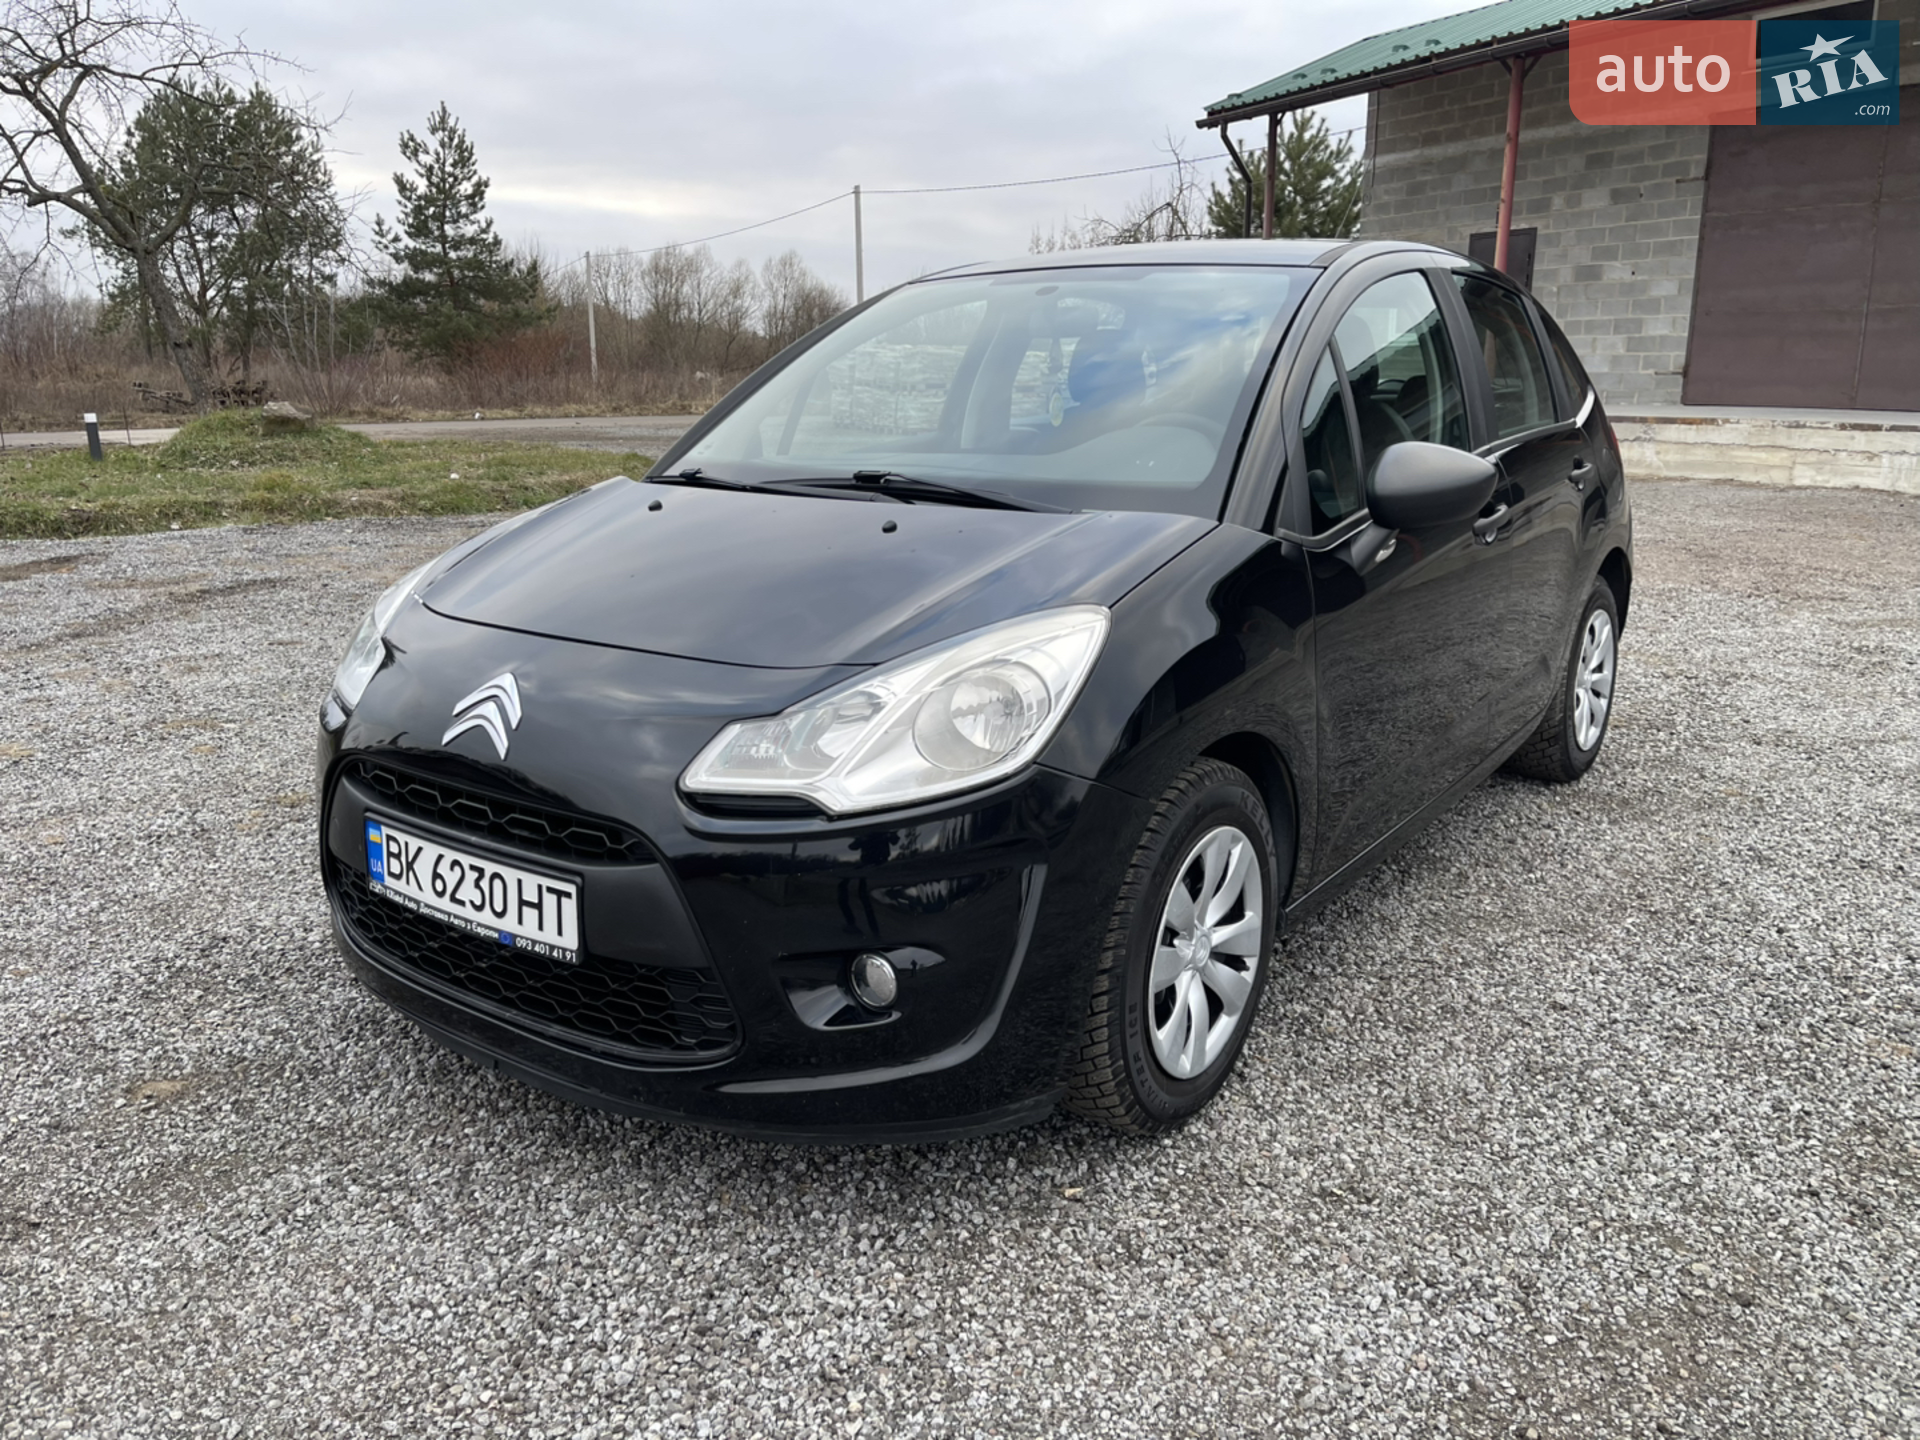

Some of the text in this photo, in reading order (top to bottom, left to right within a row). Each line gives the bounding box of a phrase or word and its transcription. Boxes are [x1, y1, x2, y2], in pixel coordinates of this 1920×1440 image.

[371, 859, 383, 874] UA
[385, 833, 573, 938] BK 6230 HT
[515, 937, 576, 963] 093 401 41 91
